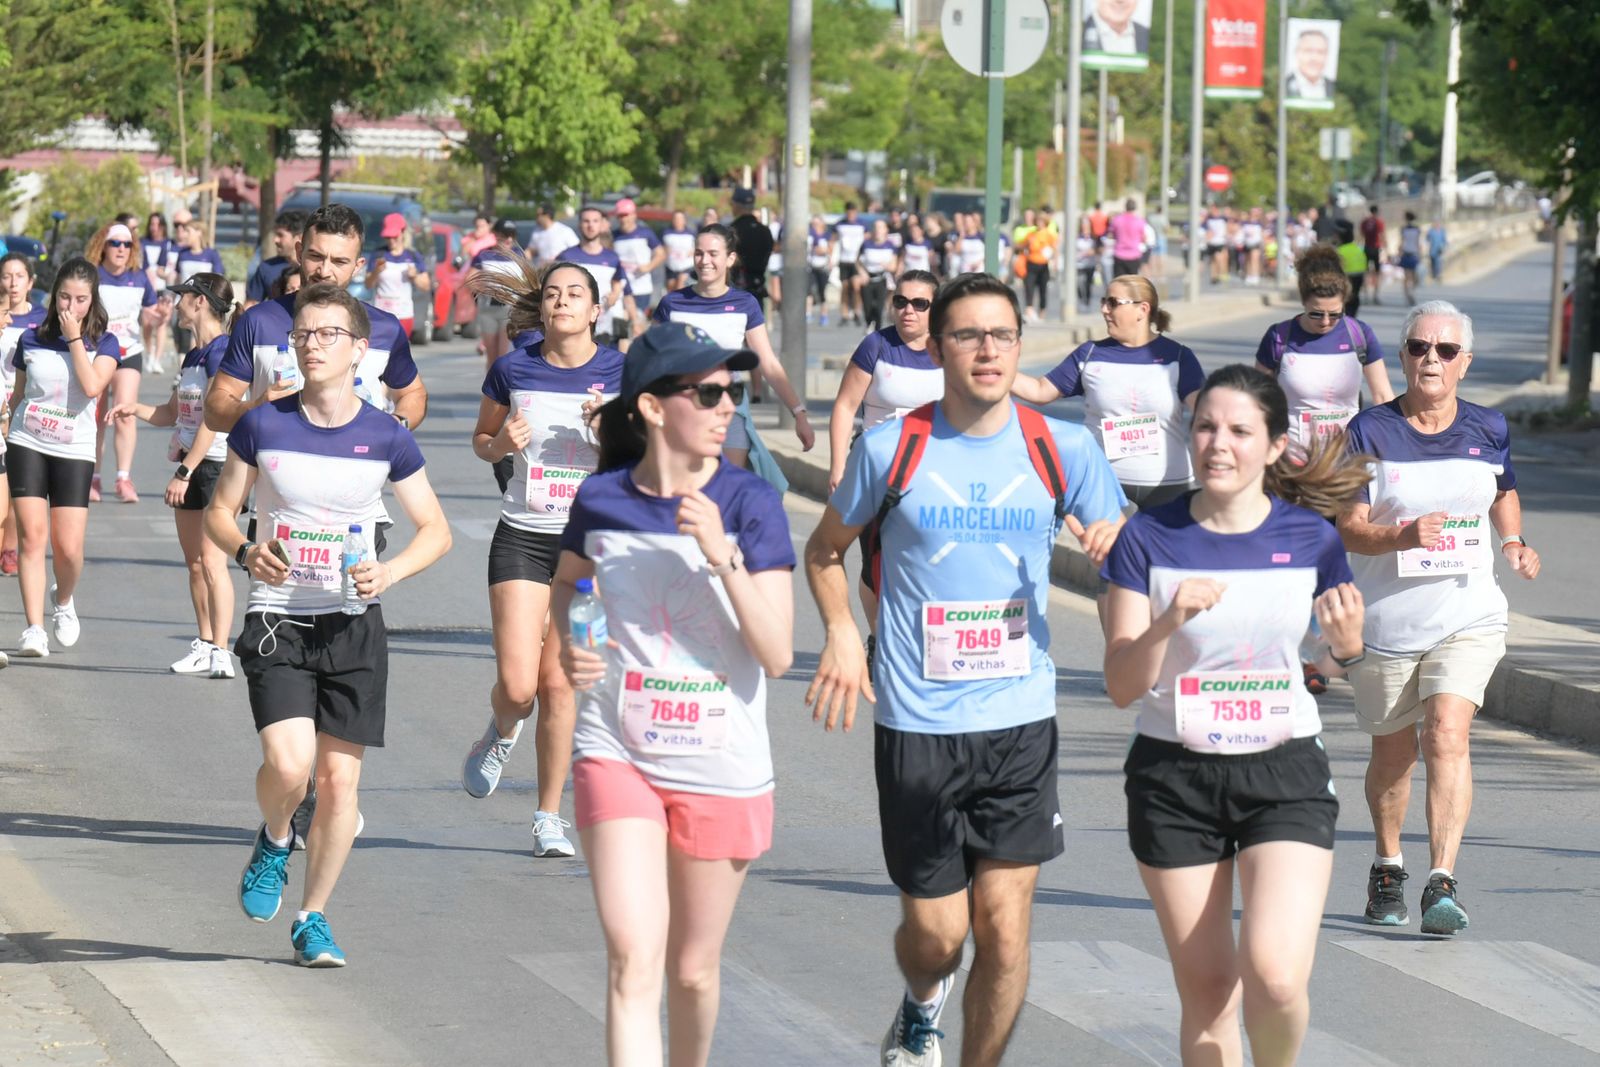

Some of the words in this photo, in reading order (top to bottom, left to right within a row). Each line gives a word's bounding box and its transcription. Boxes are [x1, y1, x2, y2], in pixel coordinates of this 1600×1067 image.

[41, 417, 59, 430] 572
[1120, 429, 1145, 441] 4031
[549, 483, 578, 498] 805
[969, 482, 987, 502] 12
[919, 506, 1035, 531] MARCELINO
[299, 546, 331, 564] 1174
[1433, 560, 1465, 569] vithas
[303, 571, 335, 582] vithas
[955, 628, 1002, 650] 7649
[969, 659, 1006, 671] vithas
[651, 699, 700, 722] 7648
[1210, 700, 1263, 721] 7538
[662, 734, 703, 745] vithas
[1226, 734, 1268, 745] vithas
